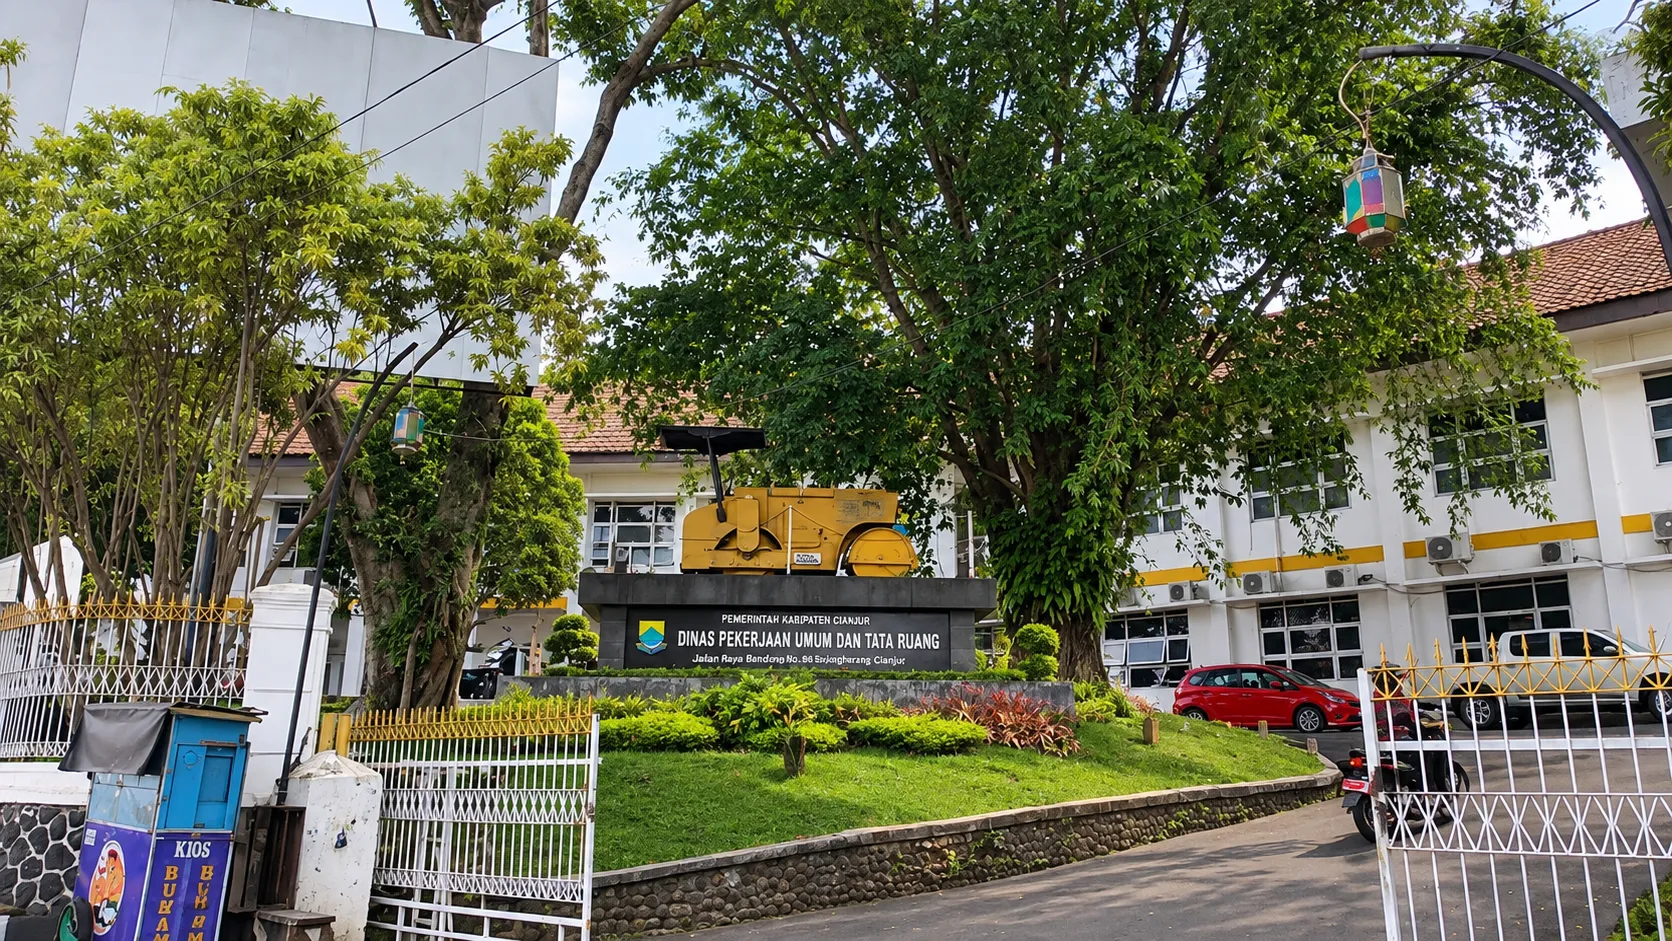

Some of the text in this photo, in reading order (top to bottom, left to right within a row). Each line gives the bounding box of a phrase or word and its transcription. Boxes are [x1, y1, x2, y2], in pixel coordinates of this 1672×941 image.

[721, 614, 779, 624] PEMERINTAH
[833, 615, 870, 625] CIANJUR
[677, 630, 940, 650] DINAS PEKERJAAN UMUM DAN TATA RUANG
[721, 654, 743, 665] Raya
[173, 840, 212, 858] KIOS
